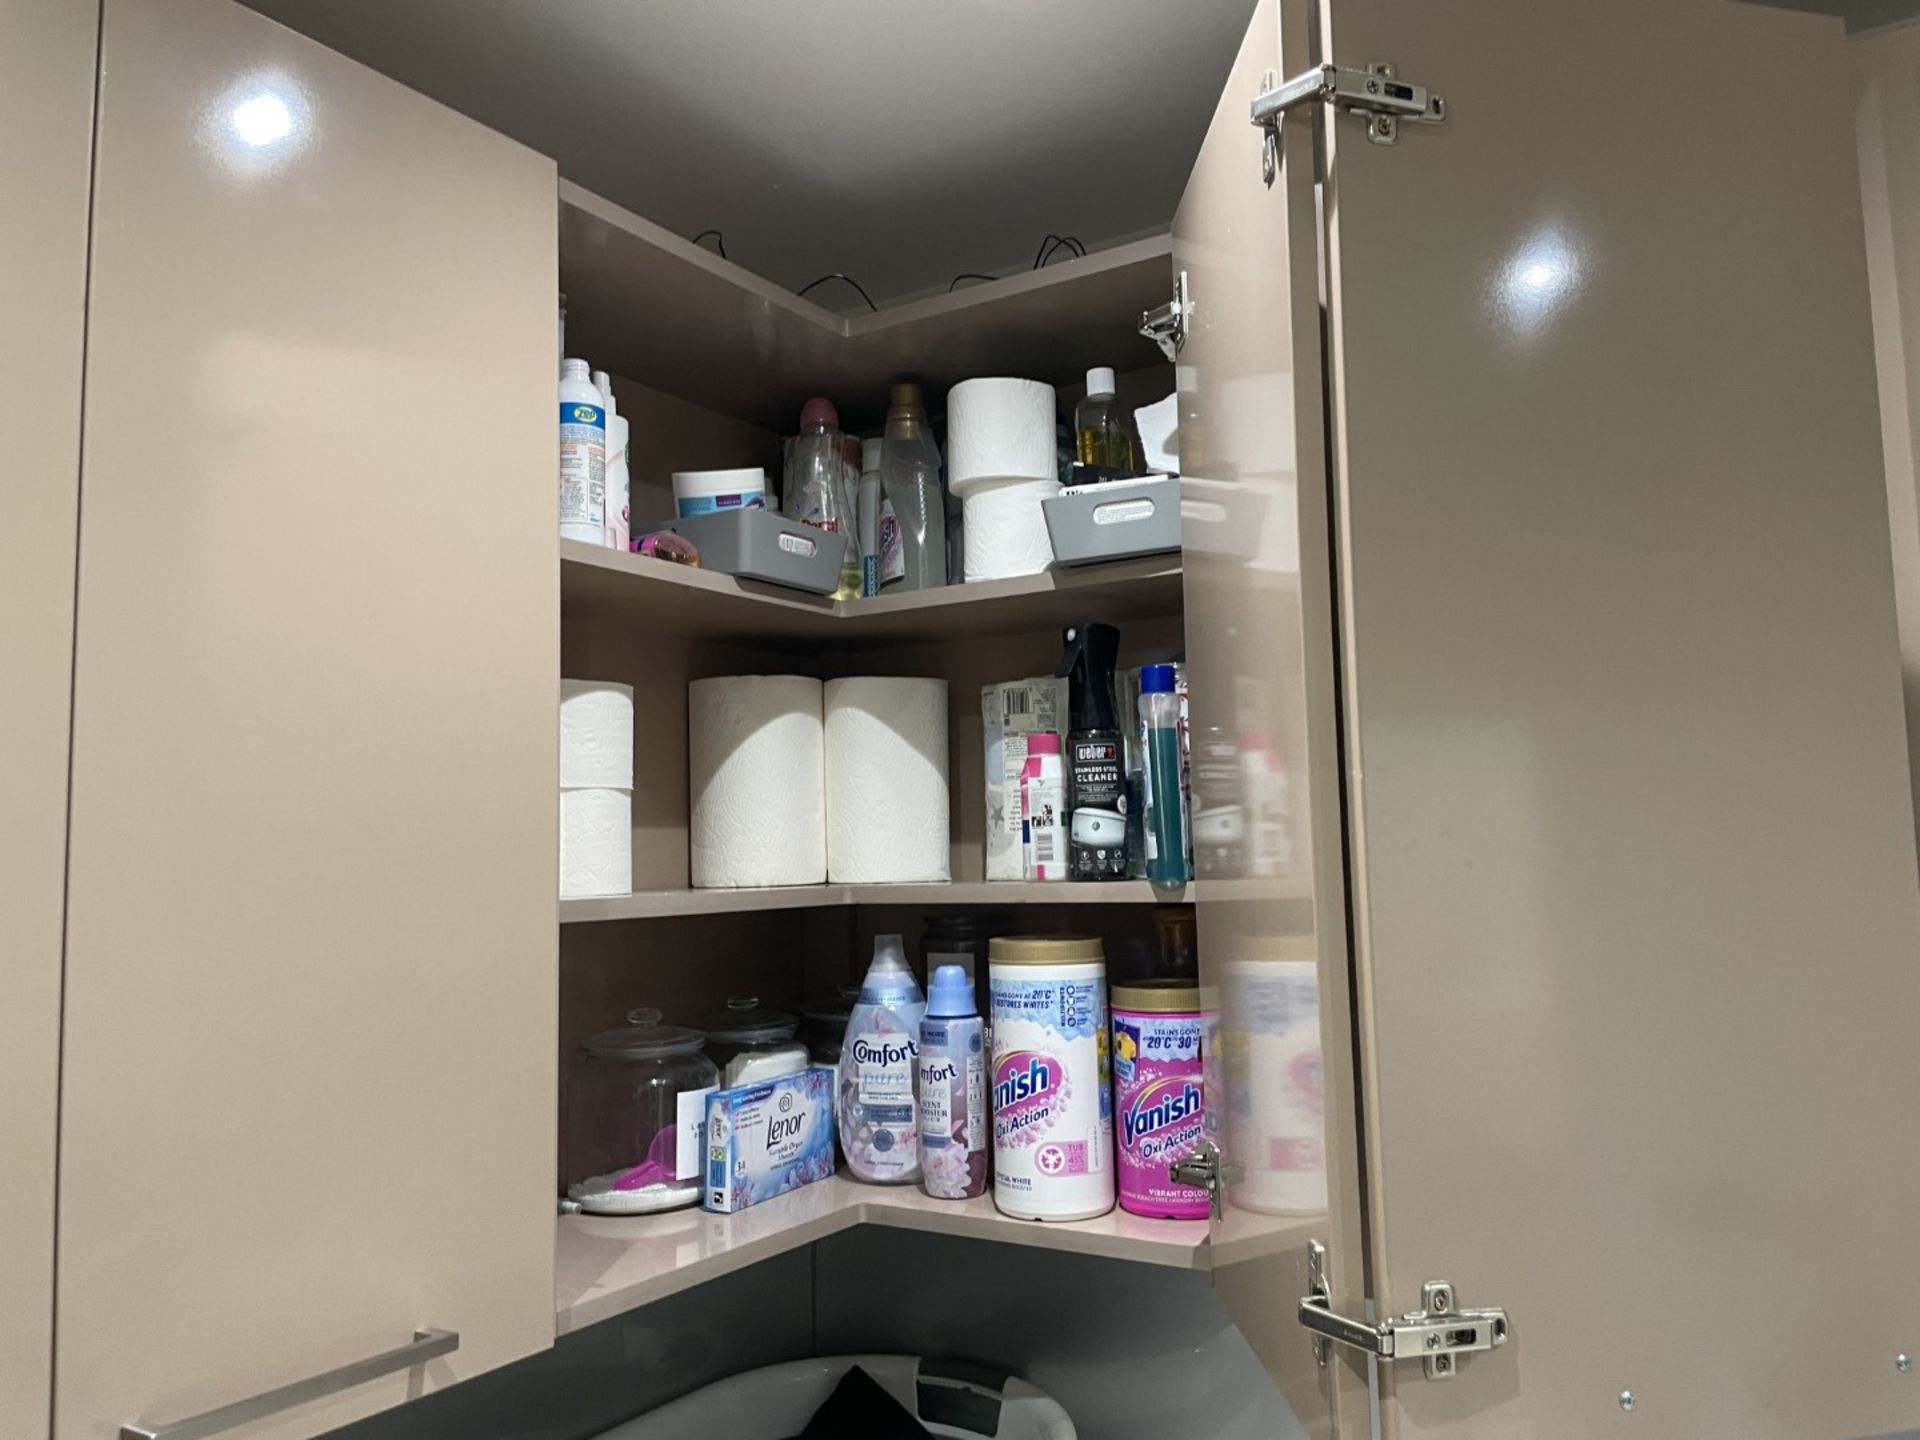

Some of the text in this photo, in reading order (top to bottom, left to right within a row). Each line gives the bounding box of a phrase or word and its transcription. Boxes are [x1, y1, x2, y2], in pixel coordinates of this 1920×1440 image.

[1075, 766, 1102, 774] STAINLESS
[1077, 773, 1118, 782] CLEANER
[1153, 1028, 1179, 1036] STAINS
[920, 1063, 957, 1085] mfort
[994, 1058, 1049, 1112] anish
[1010, 1107, 1049, 1132] Action
[1124, 1084, 1200, 1145] Vanish
[766, 1111, 806, 1151] Lenor
[1143, 1126, 1201, 1157] Oxi Action
[1148, 1188, 1209, 1198] VIBRANT COLOU
